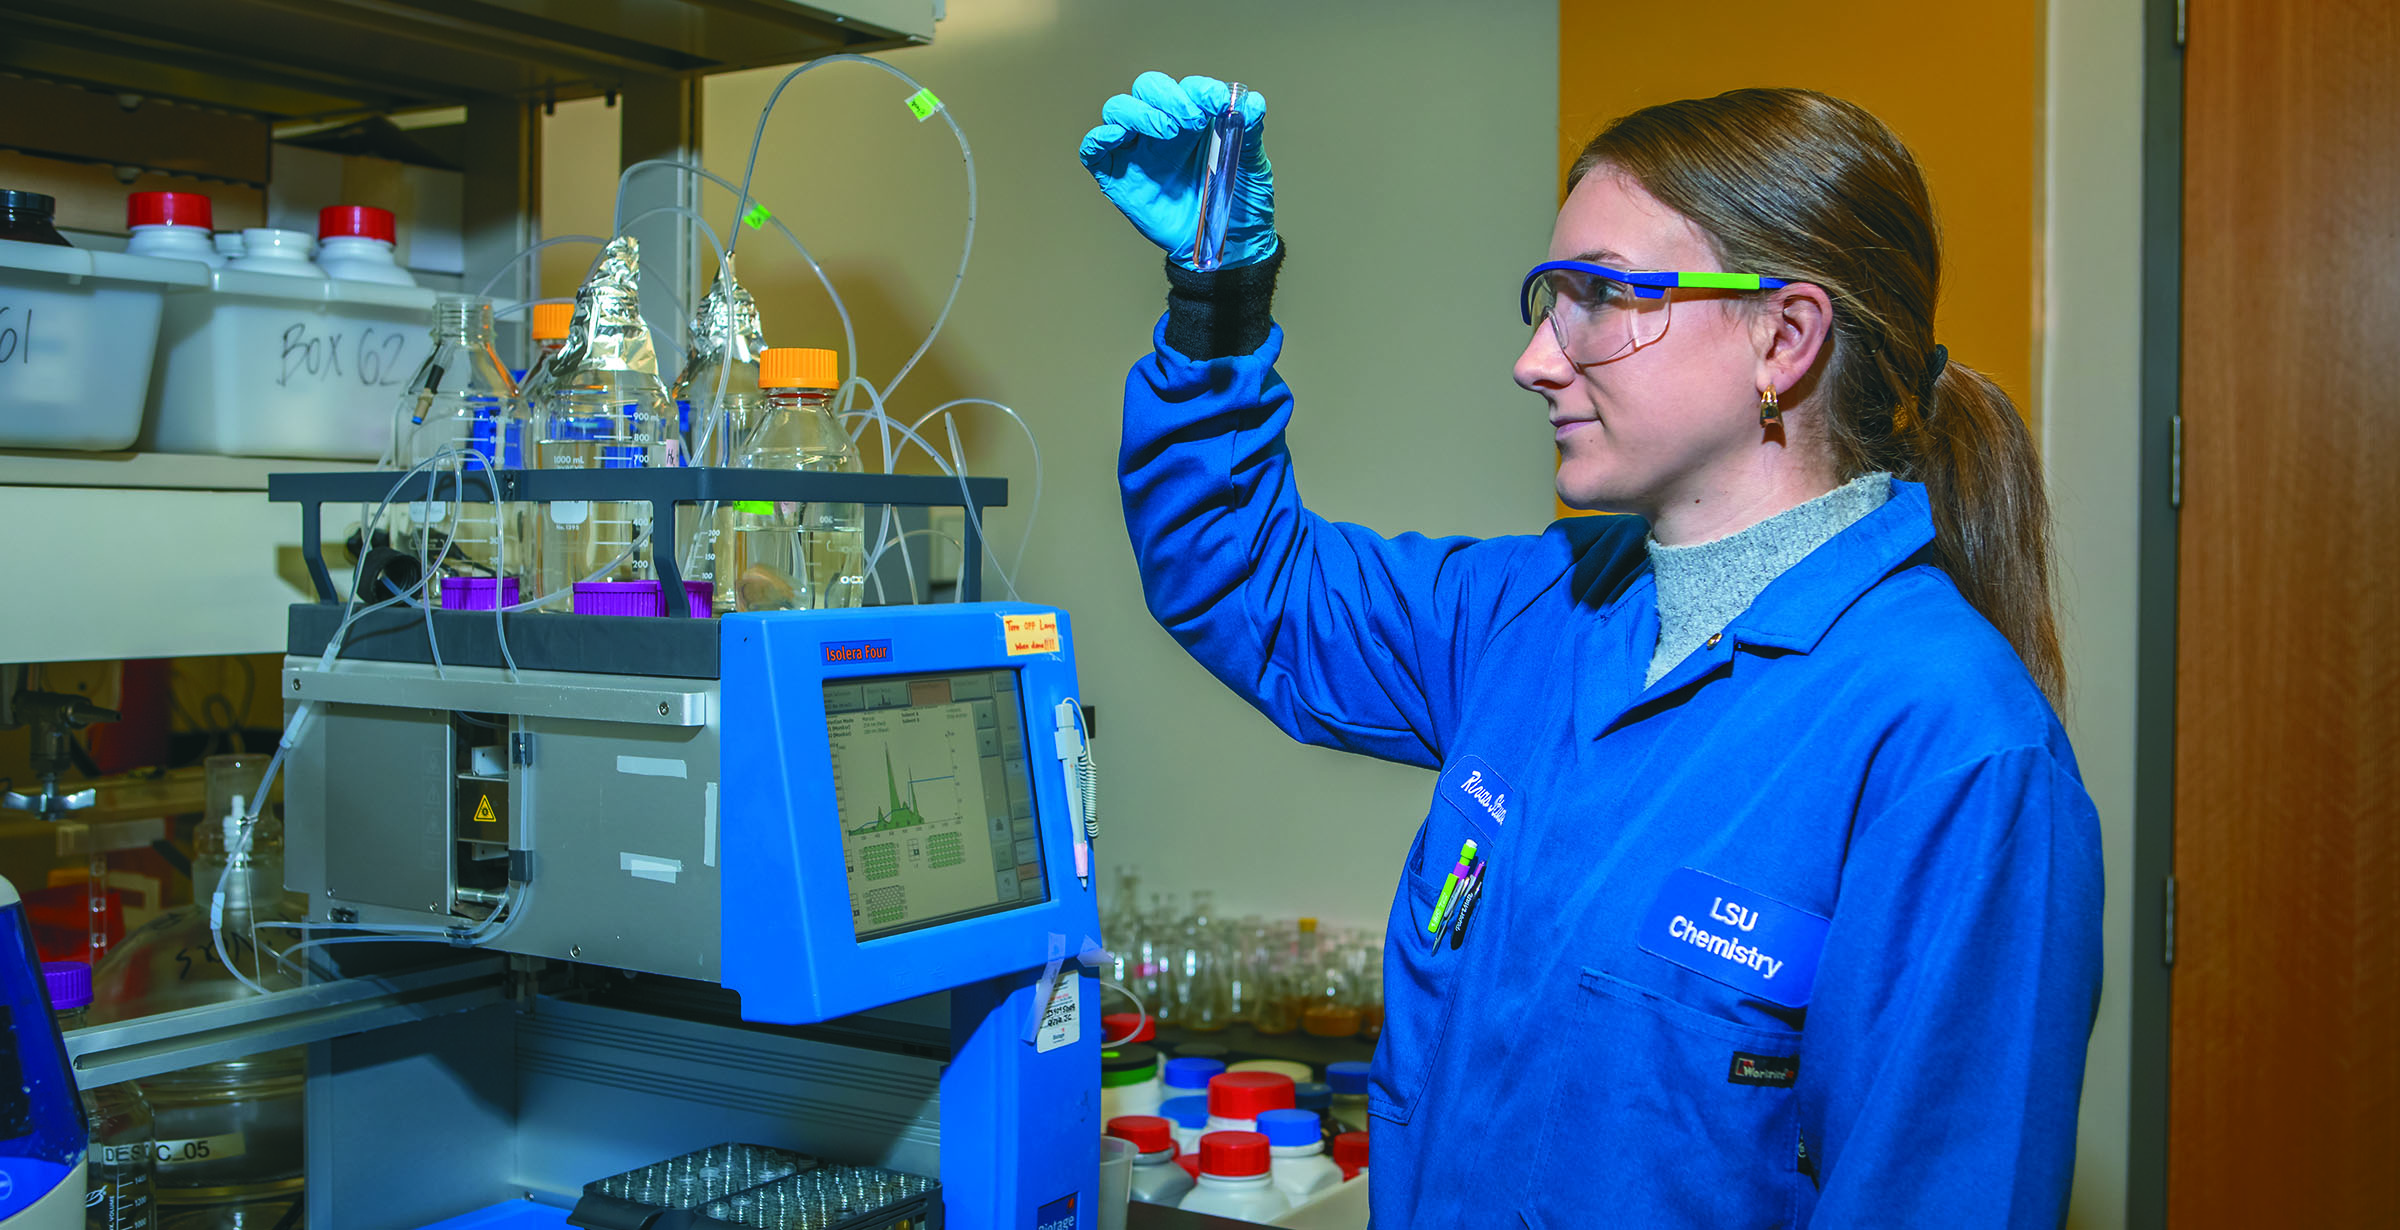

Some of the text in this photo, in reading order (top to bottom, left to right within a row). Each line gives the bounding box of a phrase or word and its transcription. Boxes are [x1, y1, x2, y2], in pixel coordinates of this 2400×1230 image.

[357, 328, 405, 387] 62
[634, 434, 650, 442] 800
[633, 454, 650, 463] 700
[632, 560, 649, 569] 200
[826, 644, 887, 662] Isolera Four
[1709, 896, 1759, 932] LSU
[1668, 915, 1784, 979] Chemistry
